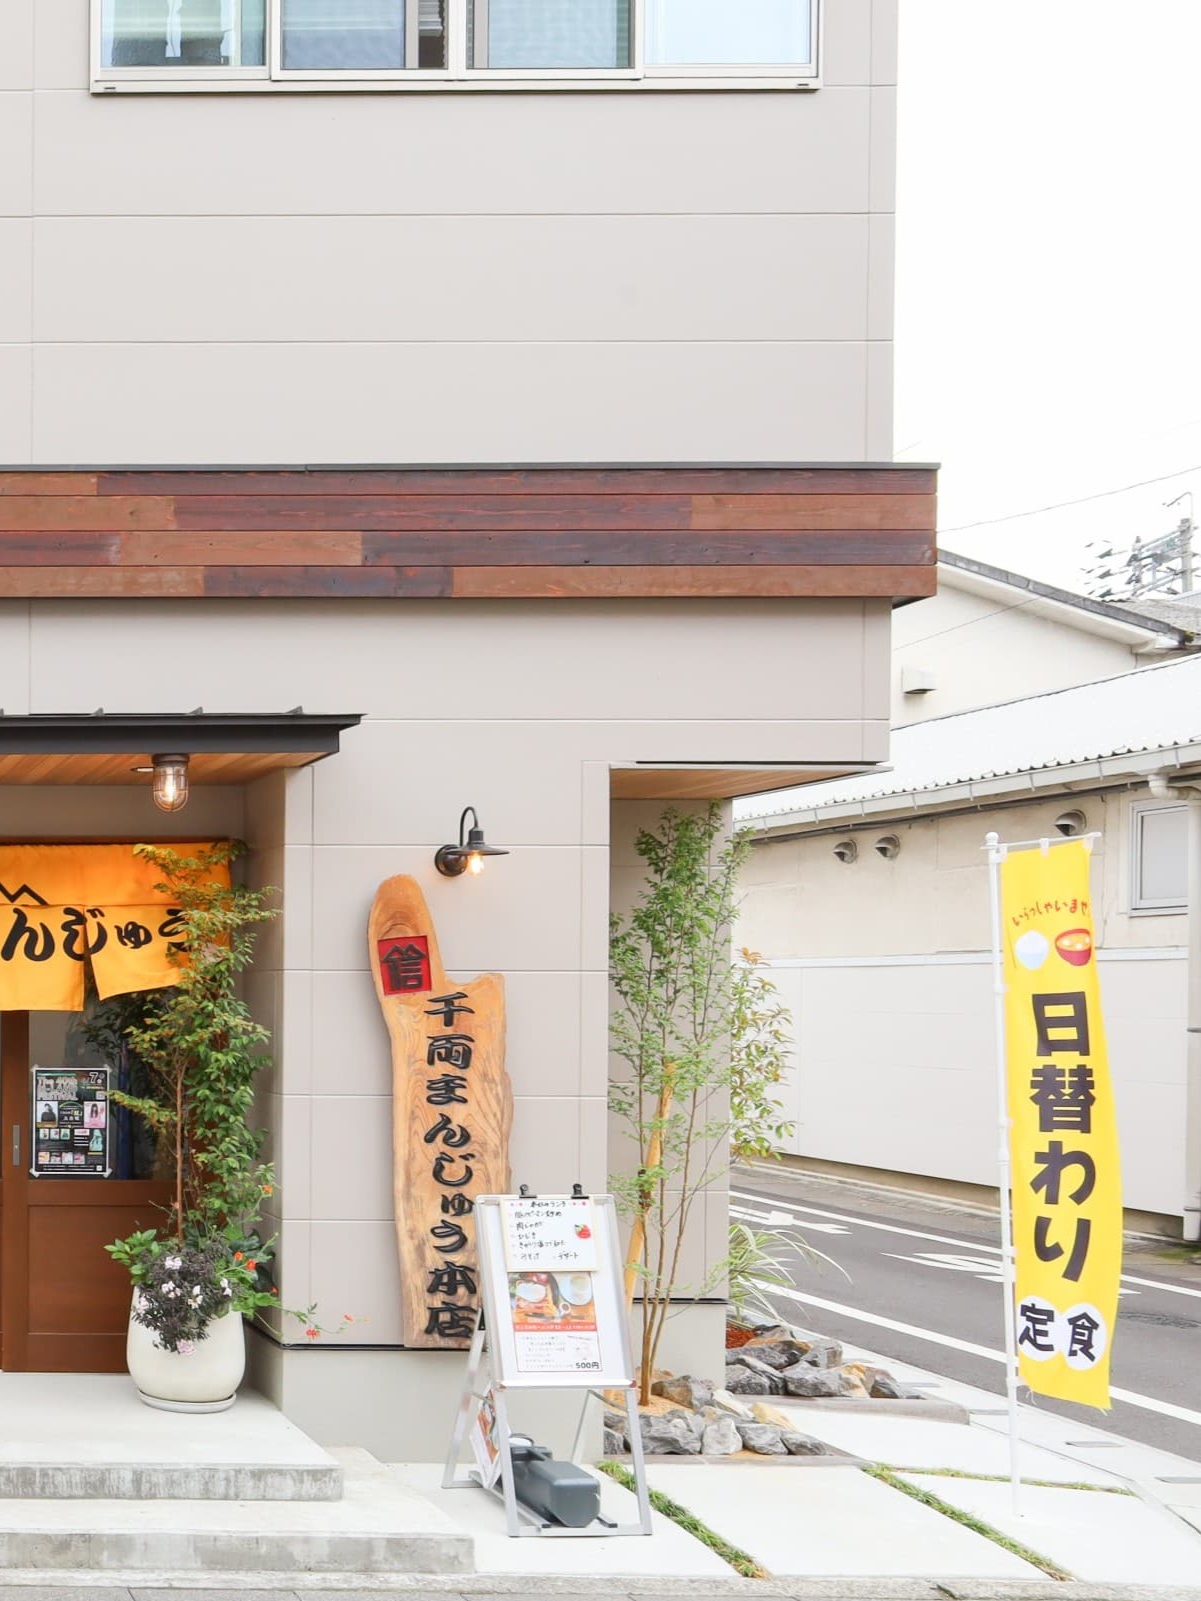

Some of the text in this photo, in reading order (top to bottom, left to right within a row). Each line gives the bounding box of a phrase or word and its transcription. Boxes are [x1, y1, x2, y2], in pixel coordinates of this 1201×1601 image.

[423, 991, 478, 1338] 千両まんじゅう本店
[1029, 991, 1096, 1283] 日替わり
[1017, 1303, 1101, 1364] 定食
